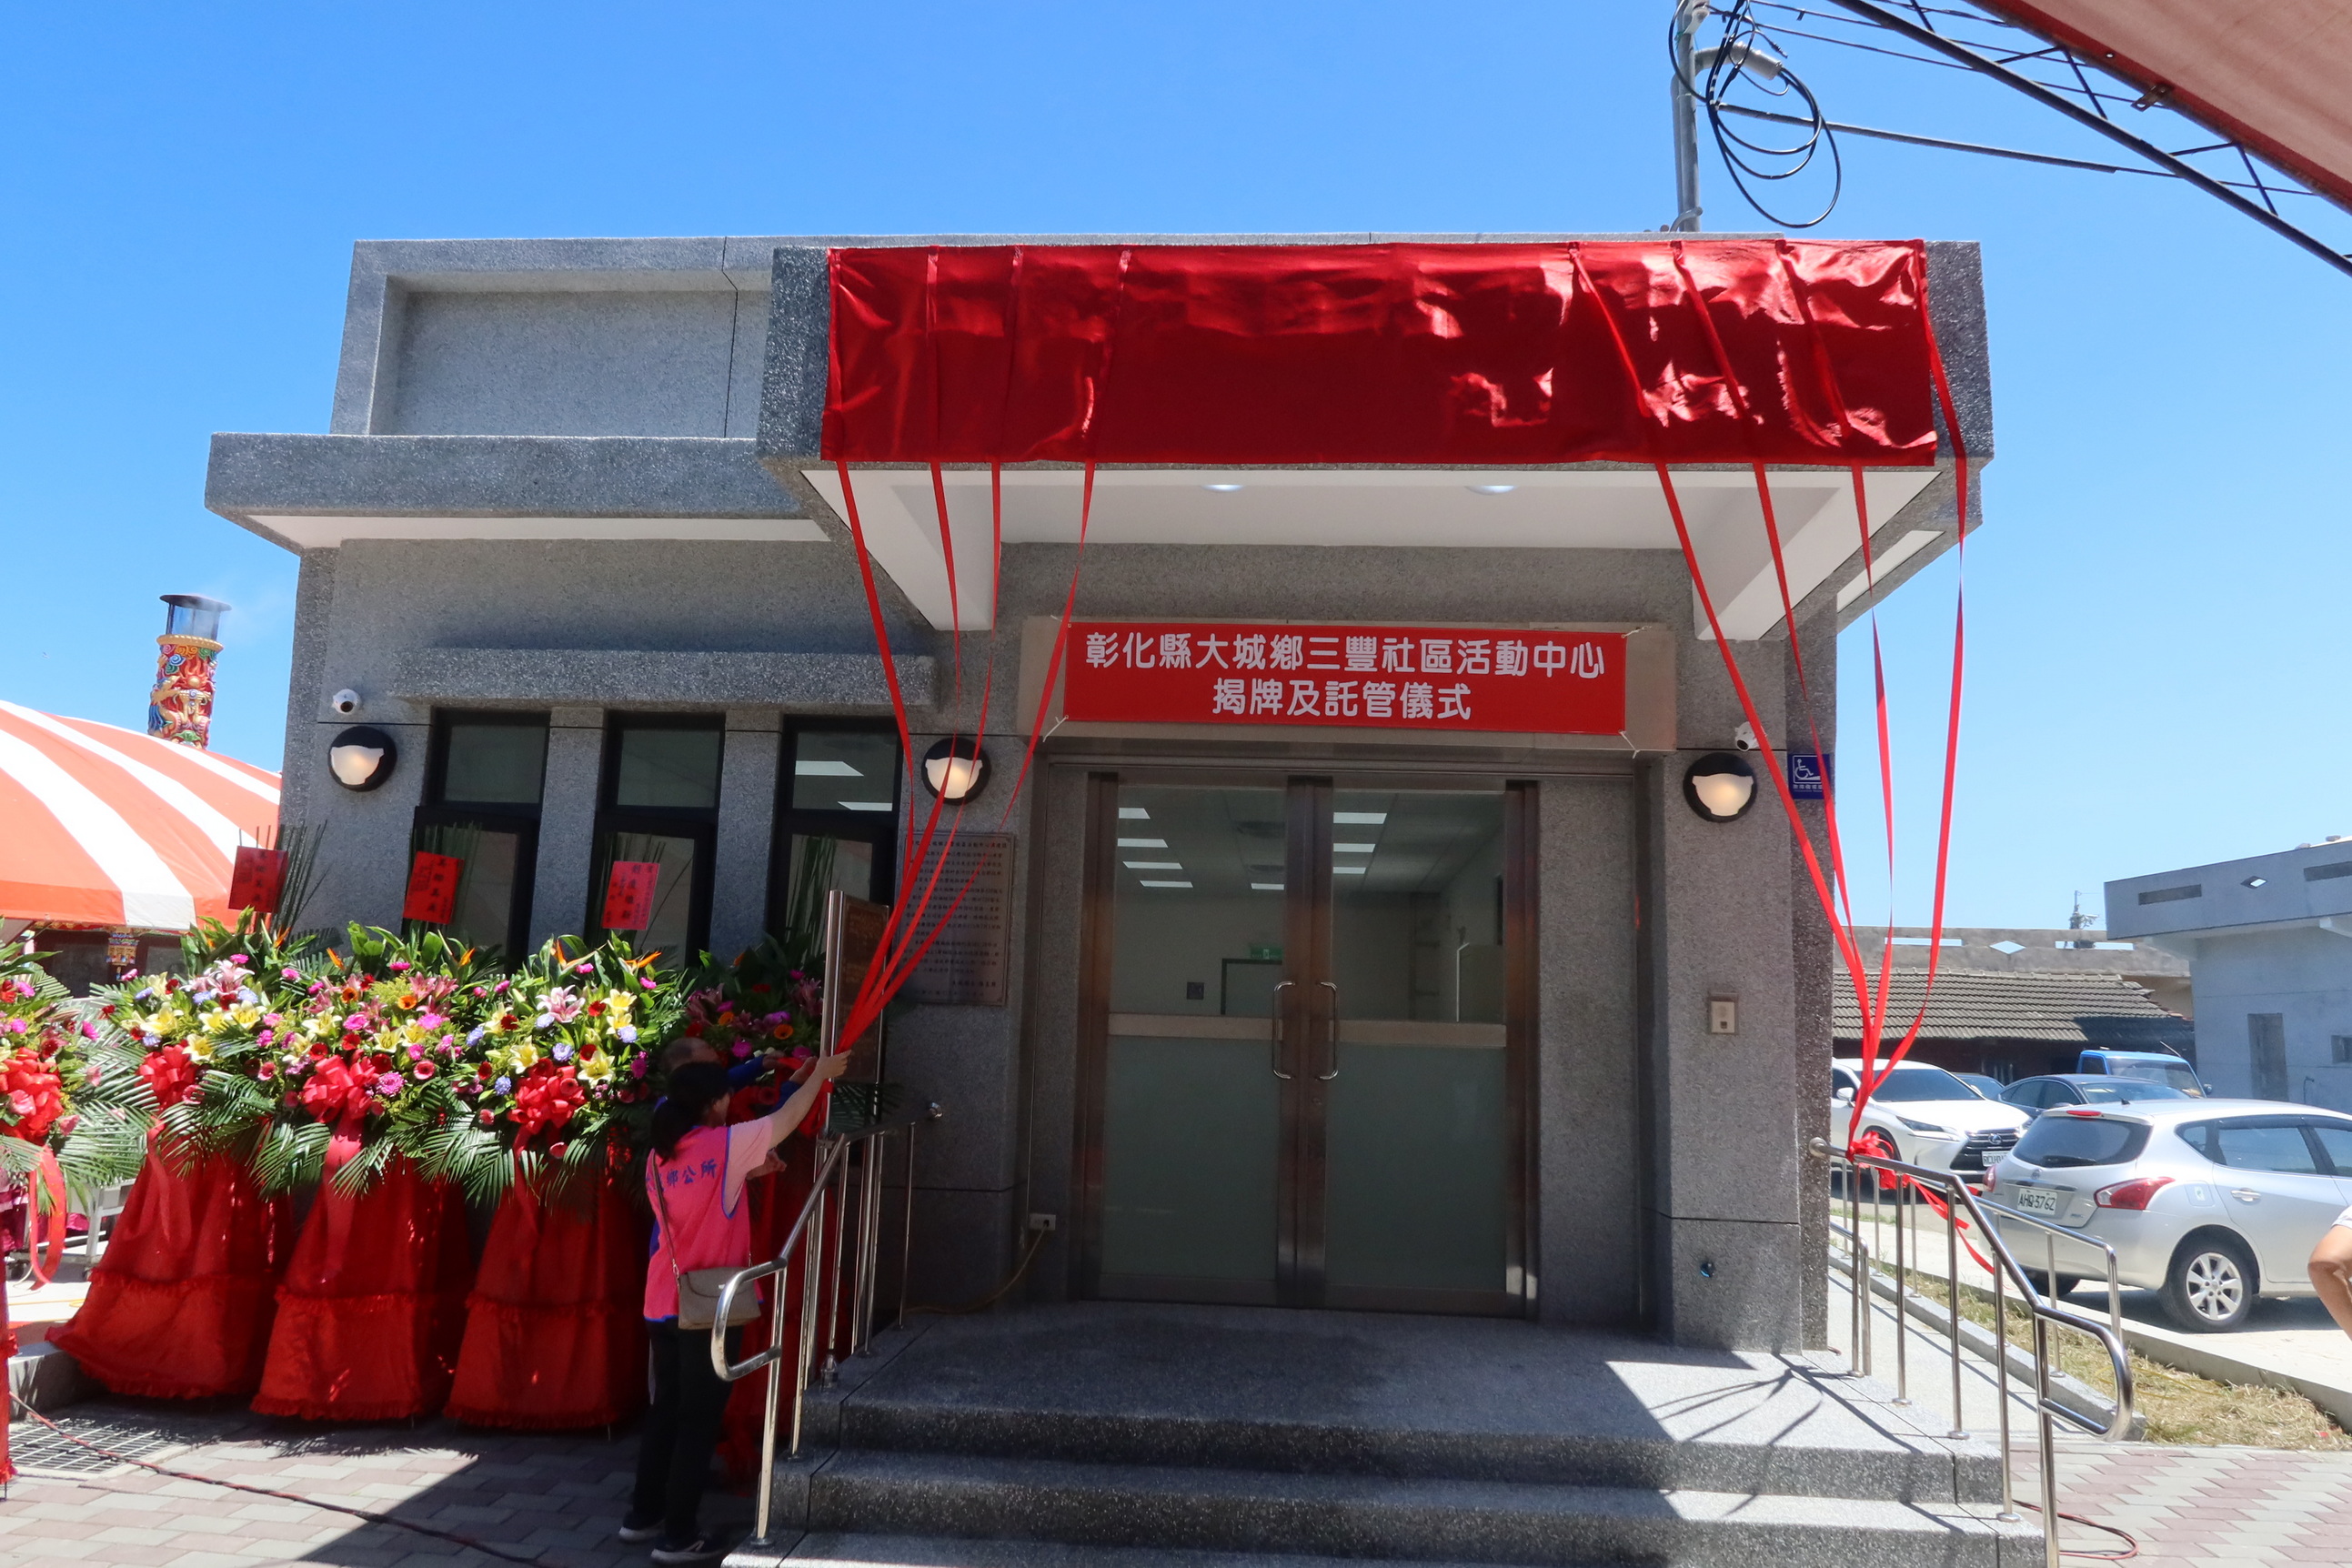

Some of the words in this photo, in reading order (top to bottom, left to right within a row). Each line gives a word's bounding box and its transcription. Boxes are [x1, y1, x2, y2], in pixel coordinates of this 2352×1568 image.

[1086, 632, 1605, 679] 彰化縣大城鄉三豐社區活動中心
[1212, 678, 1472, 720] 揭牌及託管儀式
